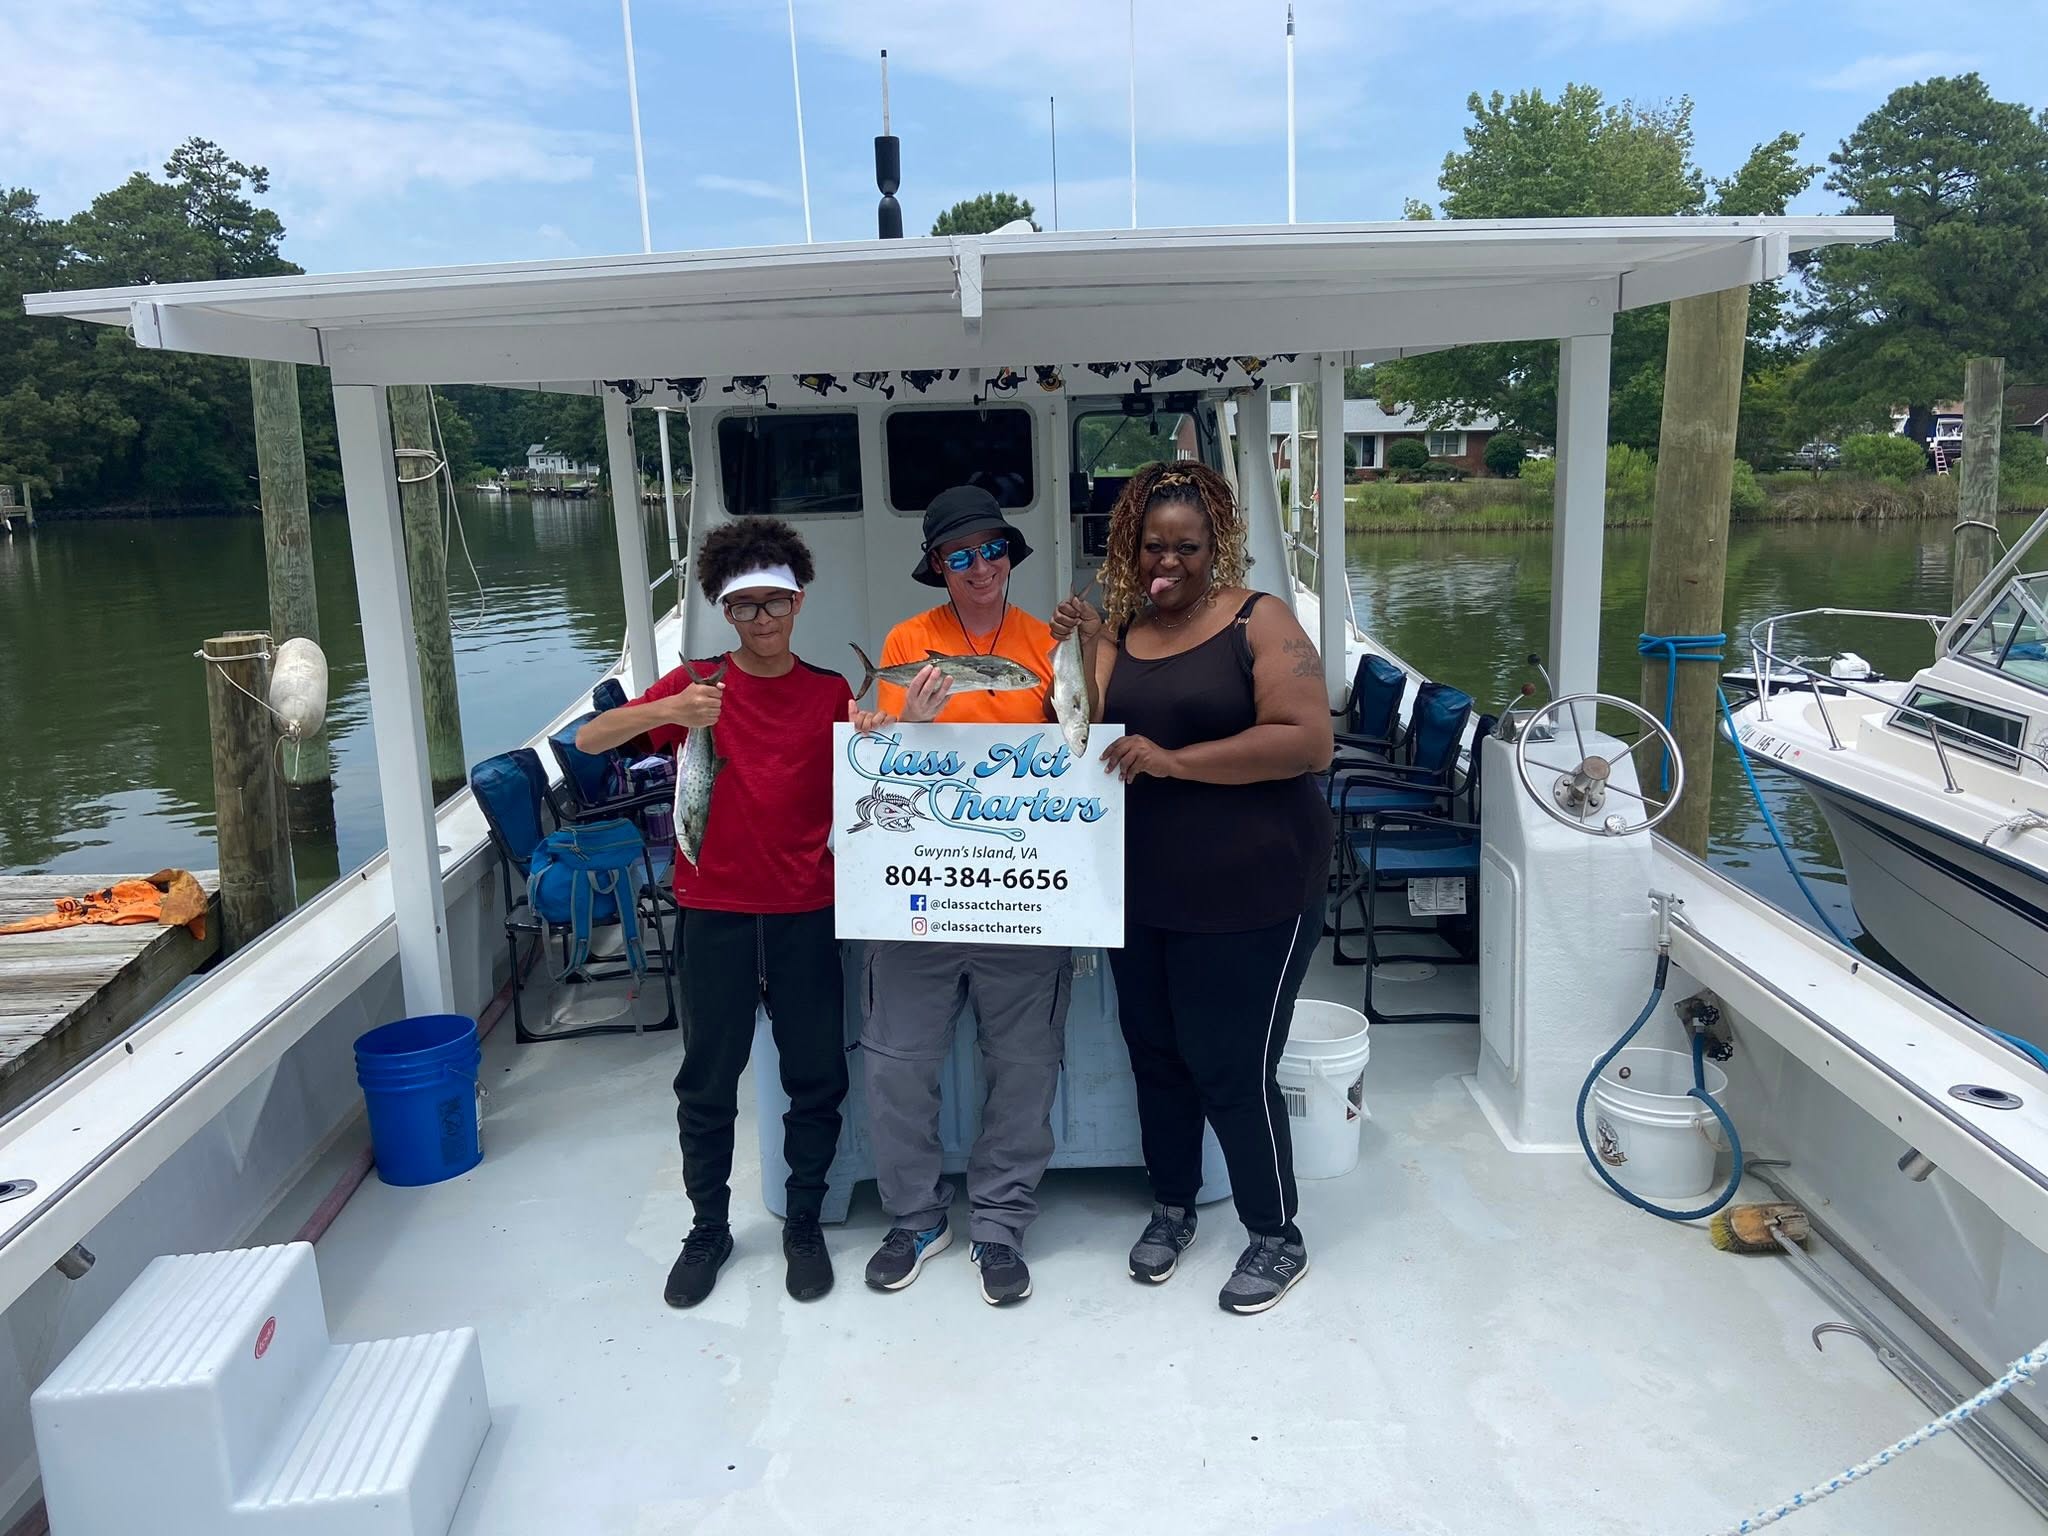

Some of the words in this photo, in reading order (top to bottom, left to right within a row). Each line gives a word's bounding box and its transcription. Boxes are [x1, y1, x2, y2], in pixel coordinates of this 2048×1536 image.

[847, 731, 966, 786] Class
[973, 733, 1071, 779] Act
[929, 778, 1108, 842] Charters
[914, 844, 969, 861] Gwynn's
[972, 845, 1017, 861] Island,
[1020, 846, 1038, 860] VA
[885, 865, 1069, 890] 804-384-6656
[930, 898, 1042, 912] @classactcharters
[930, 920, 1042, 935] @classactcharters
